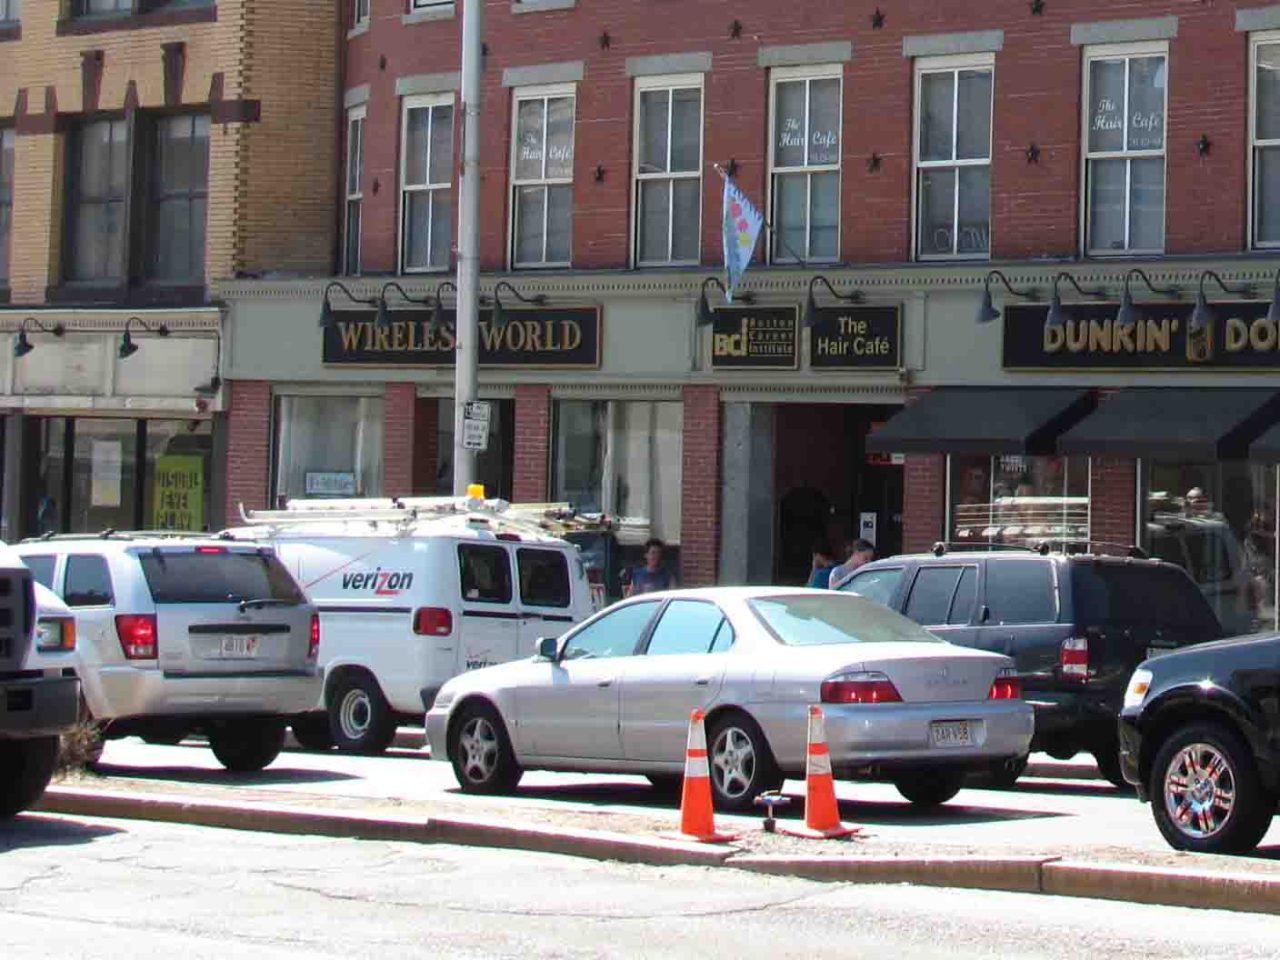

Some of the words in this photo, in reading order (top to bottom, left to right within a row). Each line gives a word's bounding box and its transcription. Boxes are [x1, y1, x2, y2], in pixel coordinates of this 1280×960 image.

[1097, 98, 1115, 113] The
[784, 117, 801, 131] The
[1092, 114, 1123, 131] Hair
[779, 131, 805, 148] Hair
[749, 317, 794, 328] Boston
[838, 317, 868, 335] The
[337, 320, 457, 352] WIRELES
[479, 319, 582, 352] WORLD
[1042, 318, 1179, 352] DUNKIN'
[749, 341, 793, 354] Institute
[818, 338, 849, 356] Hair
[342, 567, 414, 595] verizon
